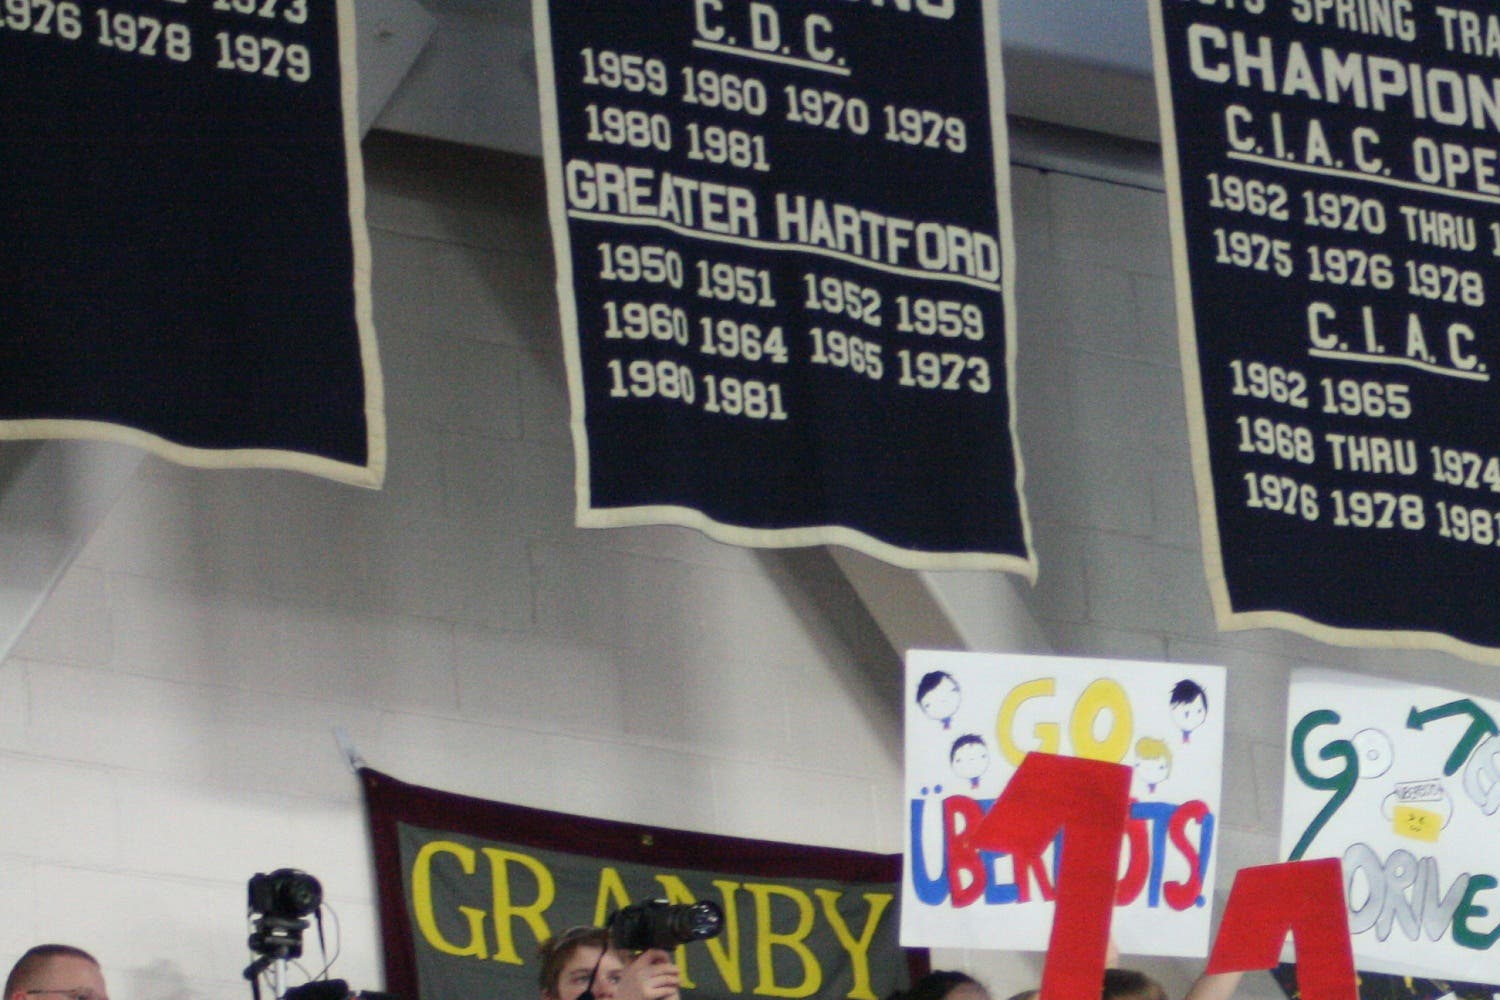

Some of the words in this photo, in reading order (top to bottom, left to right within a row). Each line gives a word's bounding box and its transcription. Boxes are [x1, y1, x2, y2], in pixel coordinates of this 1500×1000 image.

[0, 0, 82, 39] 976
[97, 9, 191, 62] 1978
[216, 32, 311, 82] 1979
[1292, 0, 1416, 42] SPRING
[581, 48, 668, 96] 1959
[682, 67, 767, 116] 1960
[784, 85, 869, 135] 1970
[884, 105, 967, 153] 1979
[585, 104, 671, 151] 1980
[687, 123, 770, 172] 1981
[566, 159, 758, 238] GREATER
[775, 193, 999, 283] HARTFORD
[1207, 173, 1289, 221] 1962
[1303, 190, 1386, 235] 1970
[1399, 205, 1477, 252] THRU
[598, 242, 683, 289] 1950
[697, 260, 776, 307] 1951
[804, 273, 882, 327] 1952
[896, 296, 984, 341] 1959
[1213, 228, 1293, 277] 1975
[1307, 245, 1394, 290] 1976
[1405, 260, 1485, 307] 1978
[604, 301, 689, 346] 1960
[700, 317, 788, 364] 1964
[809, 327, 883, 380] 1965
[898, 349, 991, 394] 1973
[608, 359, 695, 404] 1980
[703, 374, 787, 420] 1981
[1229, 359, 1309, 409] 1962
[1320, 378, 1412, 419] 1965
[1236, 416, 1315, 465] 1968
[1325, 433, 1418, 475] THRU
[1244, 472, 1319, 521] 1976
[1330, 490, 1426, 530] 1978
[996, 677, 1134, 768] GO
